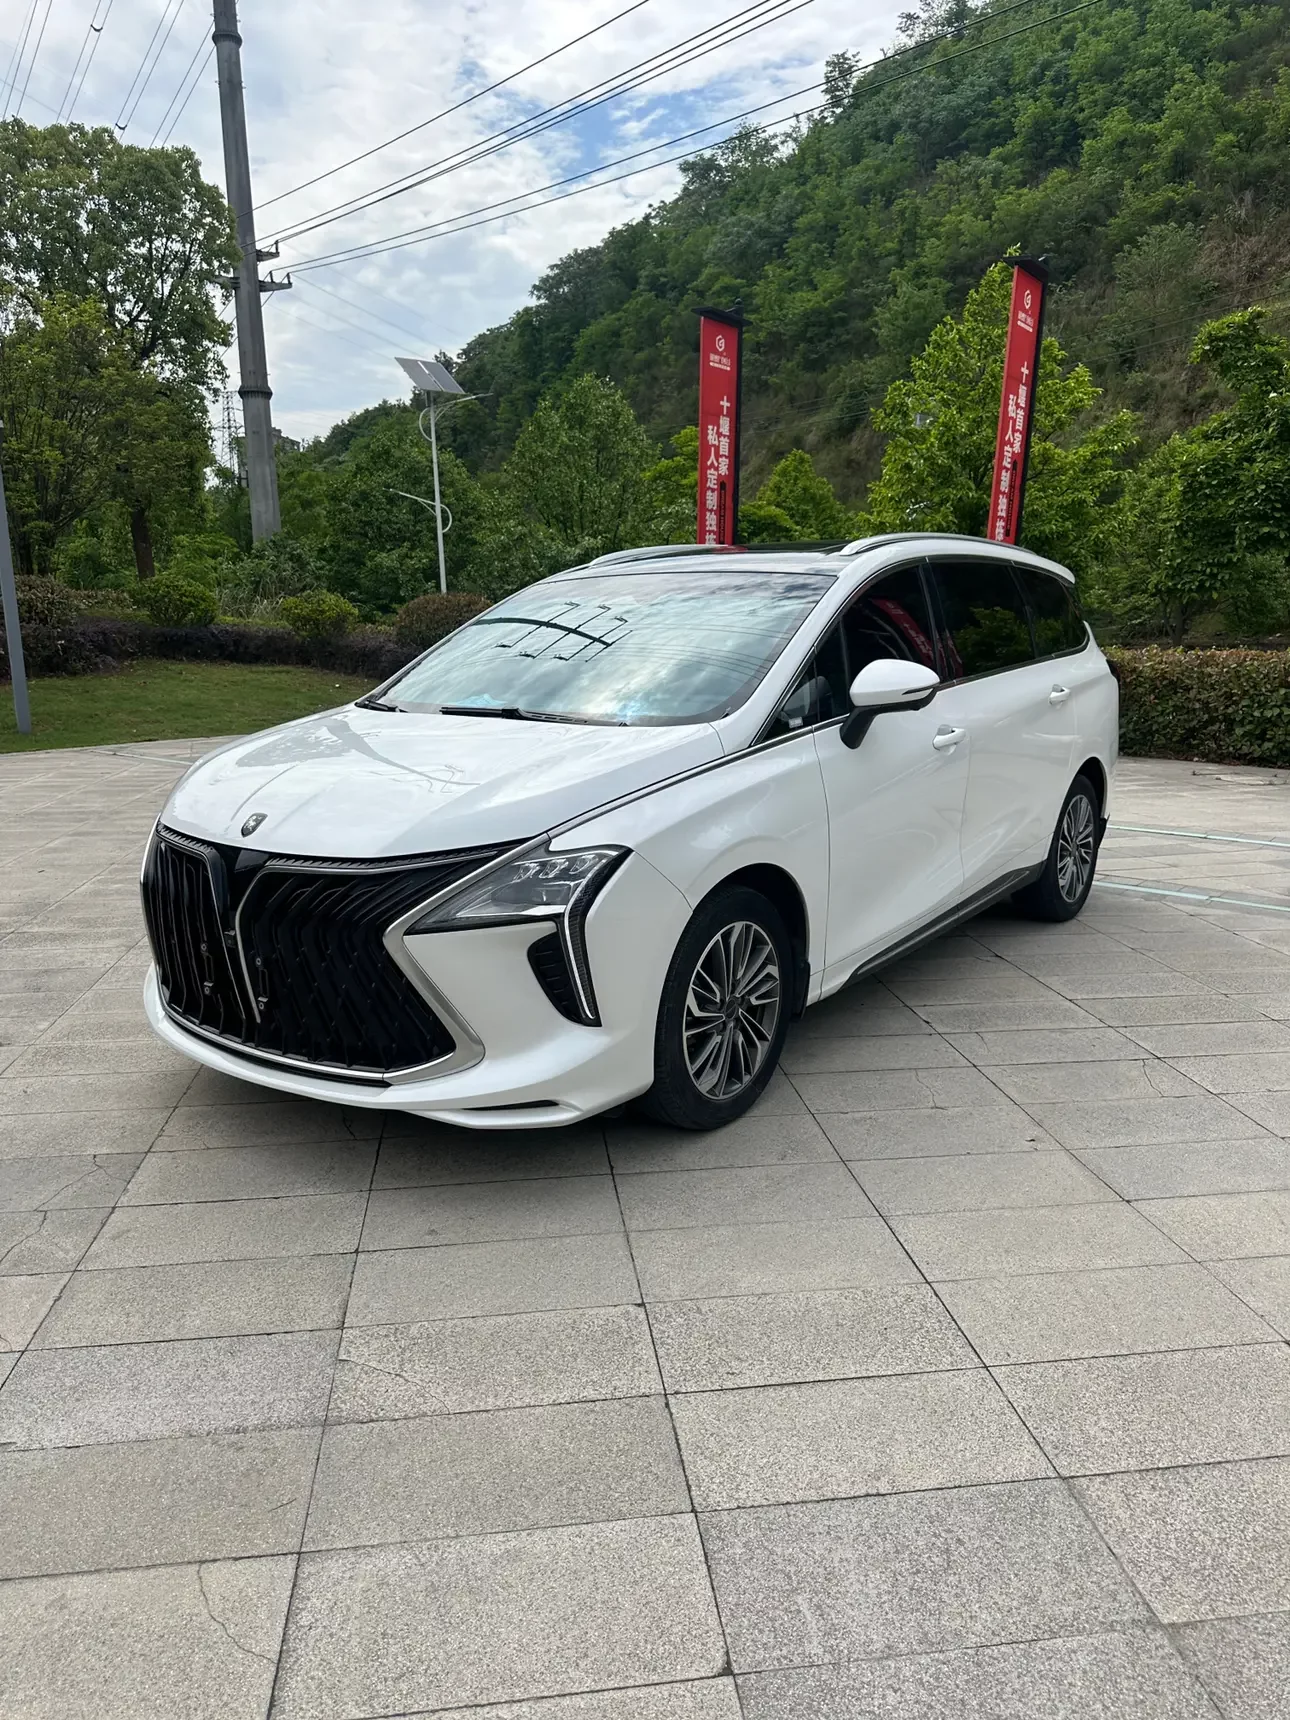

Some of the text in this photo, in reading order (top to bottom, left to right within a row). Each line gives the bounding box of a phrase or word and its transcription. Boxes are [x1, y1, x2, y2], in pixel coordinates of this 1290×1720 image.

[718, 396, 730, 476] 十堰首家
[1013, 361, 1029, 453] 十堰首家
